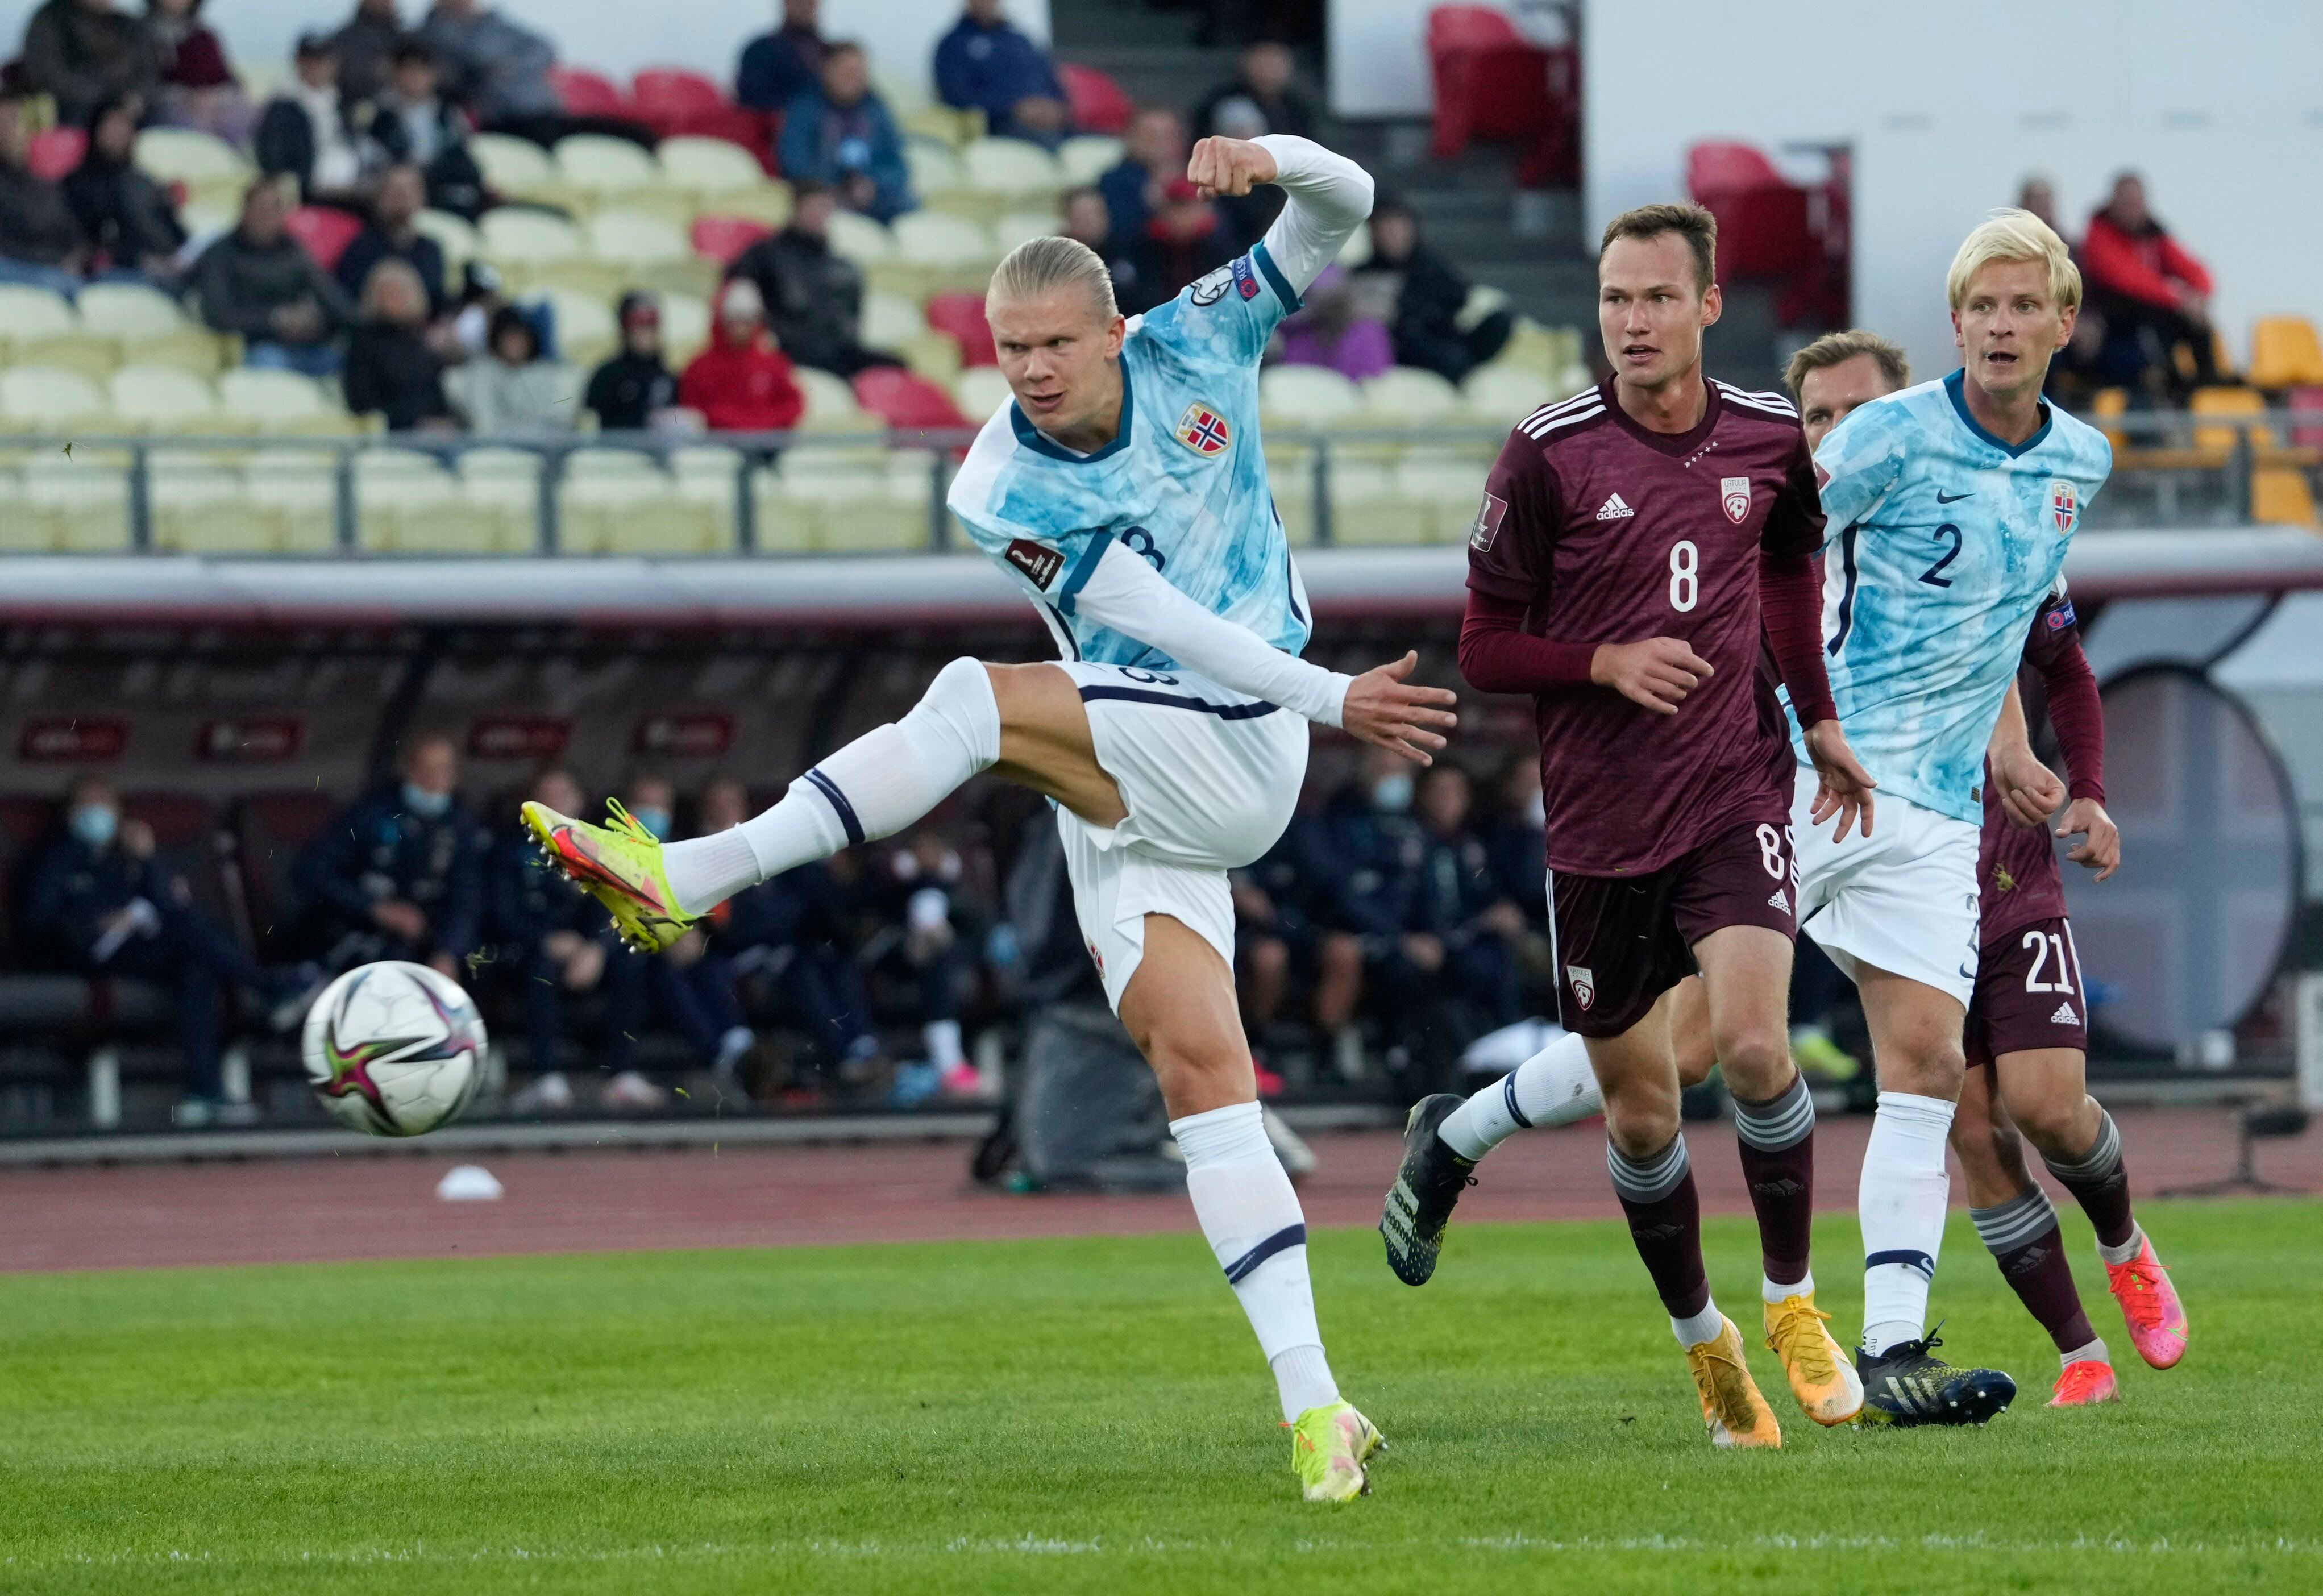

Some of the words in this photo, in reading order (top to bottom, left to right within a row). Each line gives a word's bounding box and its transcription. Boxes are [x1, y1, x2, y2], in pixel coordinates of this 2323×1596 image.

[1596, 508, 1634, 520] adidas
[1670, 540, 1698, 612] 8
[1918, 523, 1962, 588] 2
[1756, 823, 1784, 880] 8
[1768, 899, 1792, 916] adidas
[2022, 930, 2075, 995] 21
[2051, 1014, 2080, 1025] adidas
